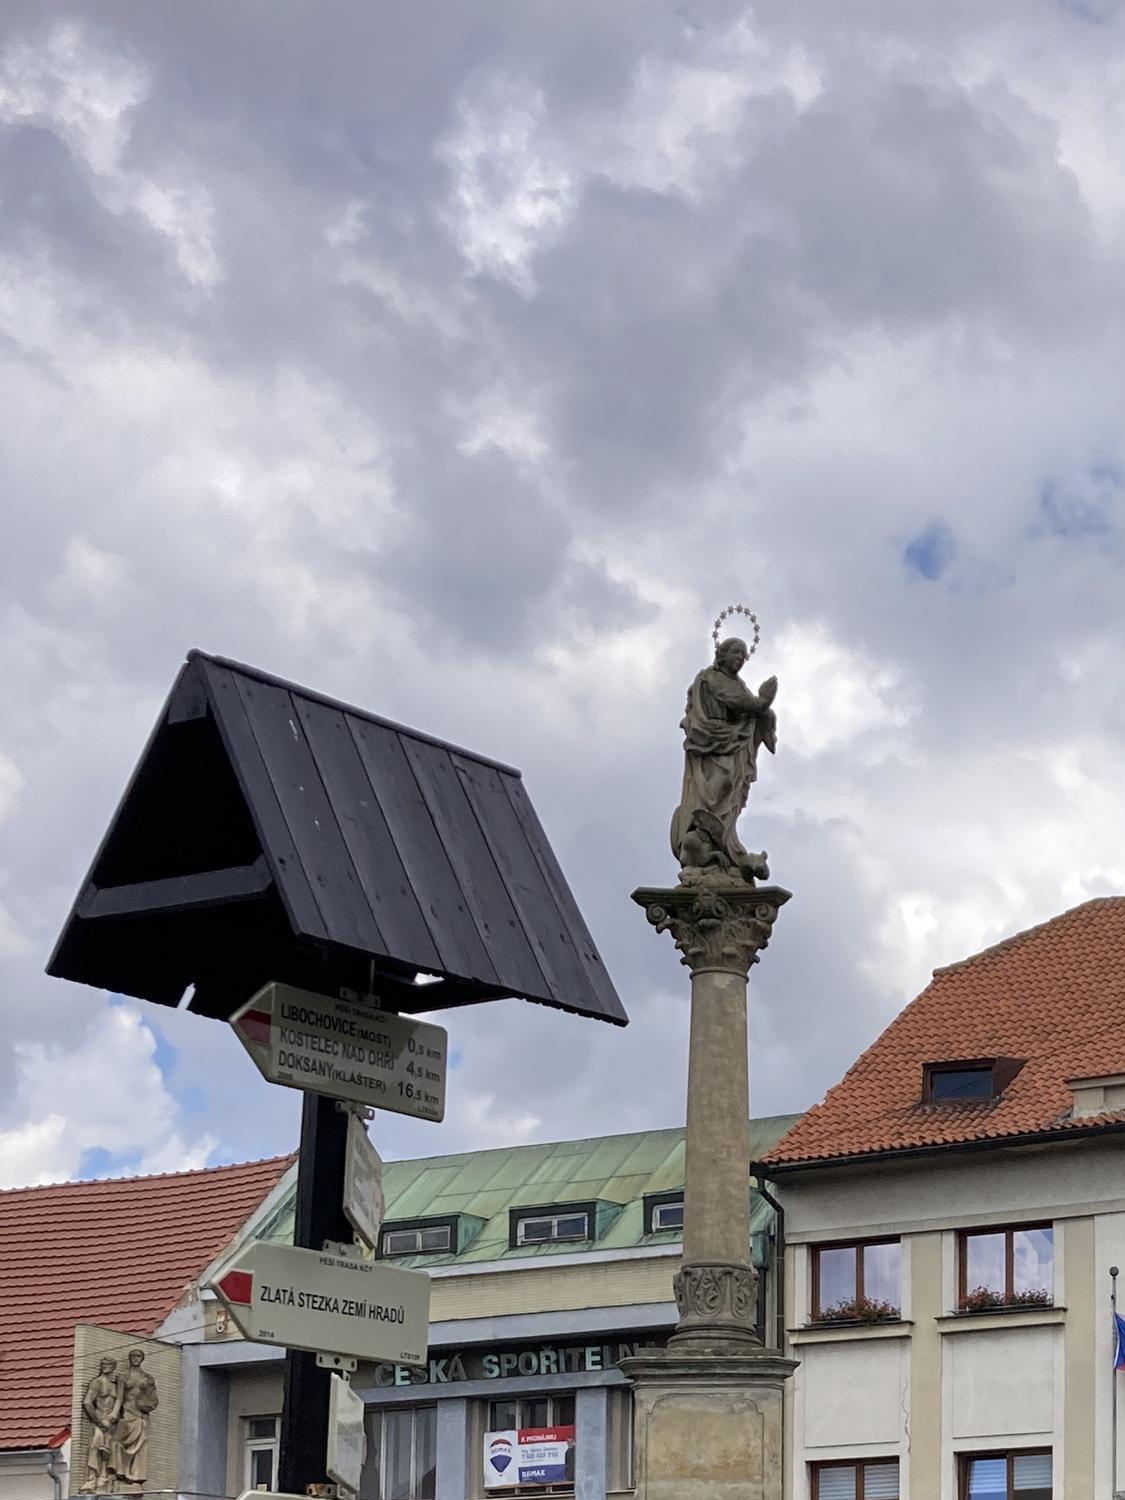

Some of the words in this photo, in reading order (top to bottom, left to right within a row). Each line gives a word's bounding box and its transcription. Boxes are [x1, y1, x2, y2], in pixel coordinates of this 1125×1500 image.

[281, 1004, 356, 1036] LIBOCHOVICE
[358, 1029, 391, 1048] (MOST)
[280, 1027, 340, 1056] KOSTELEC
[342, 1044, 365, 1062] NAD
[407, 1038, 424, 1055] 0,5
[427, 1050, 441, 1060] km
[279, 1050, 334, 1078] DOKSANY
[406, 1060, 423, 1079] 4,5
[425, 1071, 440, 1082] km
[398, 1081, 422, 1103] 16,5
[424, 1092, 438, 1105] km
[336, 1260, 358, 1271] TRASA
[360, 1264, 373, 1273] KČT
[261, 1285, 294, 1305] ZLATÁ
[298, 1292, 340, 1314] STEZKA
[342, 1300, 367, 1318] ZEMÍ
[369, 1305, 404, 1324] HRADŮ
[482, 1341, 655, 1378] SPOŘITELN
